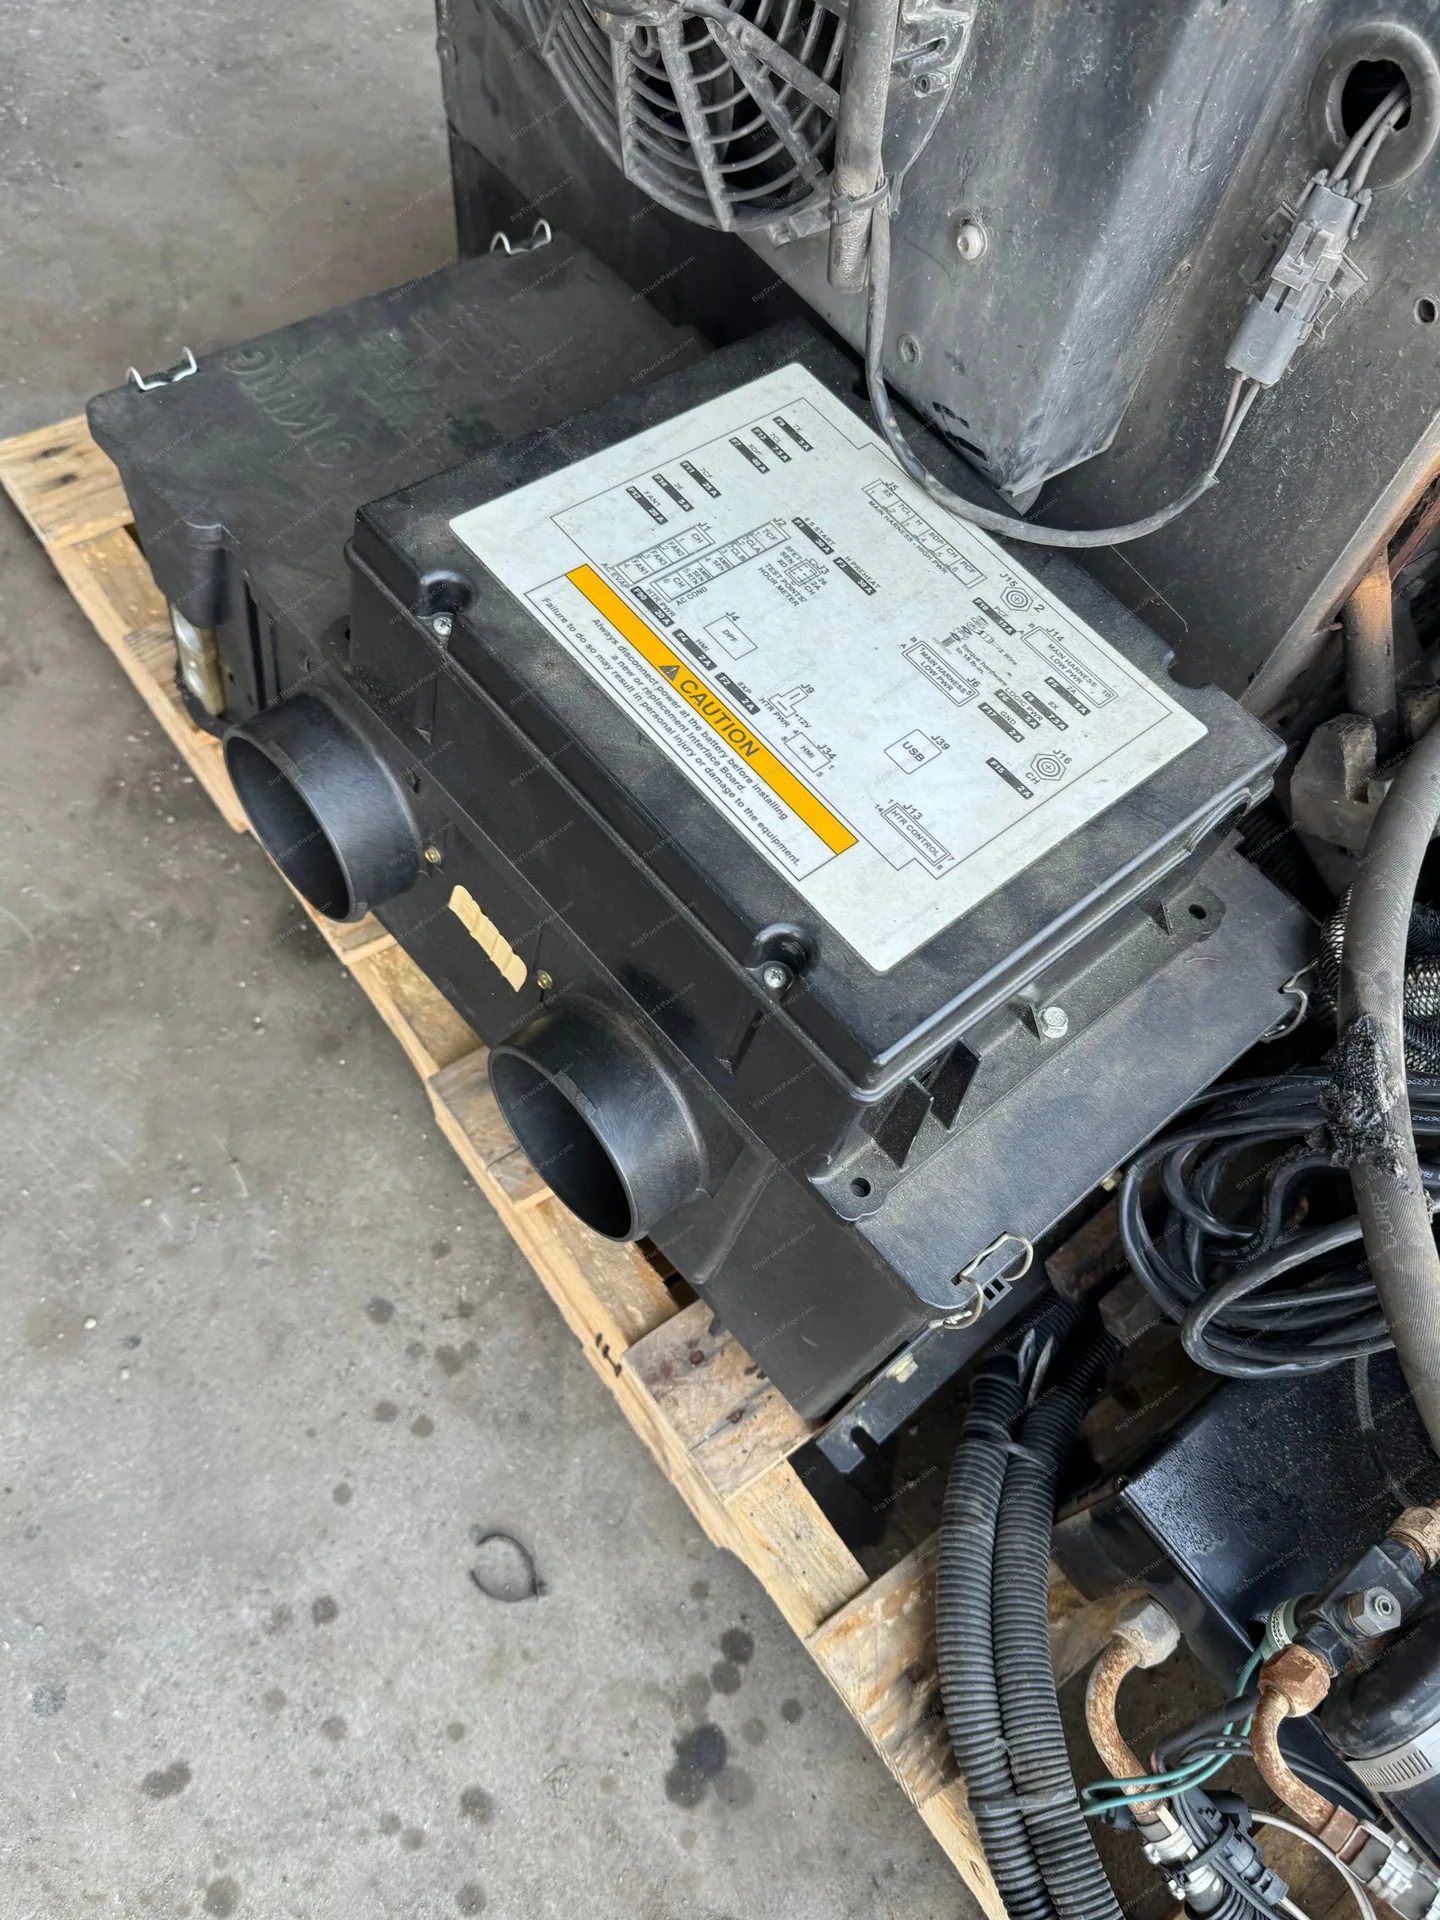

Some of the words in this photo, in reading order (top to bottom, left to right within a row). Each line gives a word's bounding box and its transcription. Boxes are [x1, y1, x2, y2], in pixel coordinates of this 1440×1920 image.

[682, 462, 694, 473] F11
[654, 475, 667, 486] F14
[883, 482, 898, 492] J5
[627, 486, 641, 499] F12
[643, 490, 660, 506] FAN1
[897, 502, 911, 516] 7CL
[696, 522, 711, 532] J1
[772, 517, 787, 527] J2
[794, 519, 804, 527] F1
[691, 533, 703, 543] CH
[762, 528, 777, 540] 7CF
[813, 526, 835, 545] START
[868, 500, 884, 515] MAIN
[883, 515, 913, 542] HARNESS
[915, 545, 932, 560] HIGH
[931, 559, 947, 574] PWR
[928, 531, 943, 544] 8DP
[667, 541, 685, 557] FAN2
[742, 535, 760, 553] 7CLA
[650, 550, 667, 565] FAN3
[727, 543, 748, 562] 7CLB
[779, 551, 794, 564] SEN
[946, 547, 958, 558] CH
[631, 559, 648, 574] FAN1
[712, 559, 724, 571] SEN
[717, 557, 732, 570] AMB
[765, 562, 783, 578] TEST
[815, 565, 829, 574] J3
[959, 560, 976, 573] PCF
[600, 563, 612, 572] AC
[610, 571, 630, 588] EVAP
[686, 573, 699, 584] RTN
[691, 570, 704, 582] SEN
[697, 567, 712, 580] AMB
[849, 561, 881, 588] PREHEAT
[672, 577, 685, 588] CH
[757, 566, 777, 585] HOUR
[775, 584, 799, 606] METER
[810, 581, 820, 590] 2A
[817, 577, 827, 585] 26
[999, 573, 1018, 588] J15
[676, 597, 687, 606] AC
[686, 586, 707, 599] COND
[804, 585, 815, 595] CH
[645, 588, 661, 602] HTR
[658, 601, 675, 617] PWR
[974, 599, 988, 610] F10
[1033, 604, 1044, 613] 2
[725, 611, 740, 621] J4
[993, 605, 1009, 617] PCF
[676, 632, 687, 641] F4
[722, 629, 738, 642] DPF
[1045, 628, 1064, 642] J14
[695, 638, 709, 651] HMI
[962, 653, 971, 661] 18
[1003, 652, 1017, 665] Wire
[961, 643, 981, 662] Torque
[979, 661, 1007, 686] hardware
[1047, 643, 1065, 659] MAIN
[1064, 658, 1097, 687] HARNESS
[1049, 654, 1067, 669] LOW
[1065, 668, 1082, 684] PWR
[920, 651, 937, 666] MAIN
[935, 665, 966, 693] HARNESS
[920, 661, 938, 676] LOW
[935, 675, 953, 691] PWR
[719, 675, 730, 685] F2
[966, 678, 980, 687] J6
[1047, 678, 1058, 687] F5
[800, 684, 814, 693] J9
[1066, 685, 1076, 694] 2A
[1102, 689, 1111, 698] 10
[982, 705, 996, 716] F17
[1004, 687, 1027, 706] LOGIC
[1025, 706, 1043, 721] PWR
[679, 679, 760, 757] CAUTION
[758, 697, 774, 712] HTR
[772, 711, 790, 727] PWR
[1000, 710, 1016, 725] GND
[591, 619, 618, 645] Always
[617, 645, 658, 686] disconnect
[654, 685, 681, 708] power
[679, 709, 690, 718] at
[687, 717, 701, 731] the
[700, 730, 728, 758] battery
[726, 757, 753, 784] before
[751, 783, 787, 820] installing
[794, 713, 811, 728] +12V
[541, 597, 567, 623] Failure
[566, 623, 576, 632] to
[574, 632, 586, 643] do
[585, 643, 596, 653] so
[595, 654, 613, 670] may
[611, 670, 635, 692] result
[632, 692, 642, 701] in
[638, 701, 676, 734] personal
[672, 733, 696, 756] injury
[694, 757, 705, 766] or
[704, 767, 735, 798] damage
[734, 797, 744, 807] to
[743, 807, 757, 821] the
[757, 822, 799, 866] equipment.
[616, 661, 634, 676] new
[633, 677, 644, 685] or
[641, 686, 689, 733] replacement
[686, 732, 720, 766] Interface
[719, 766, 745, 793] Board.
[930, 735, 950, 750] J39
[800, 745, 814, 758] HMI
[816, 744, 836, 760] J34
[902, 741, 924, 761] USB
[1052, 749, 1072, 764] J16
[990, 760, 1005, 773] F15
[1025, 772, 1040, 784] CH
[901, 804, 922, 821] J13
[890, 810, 907, 825] HTR
[906, 824, 938, 857] CONTROL
